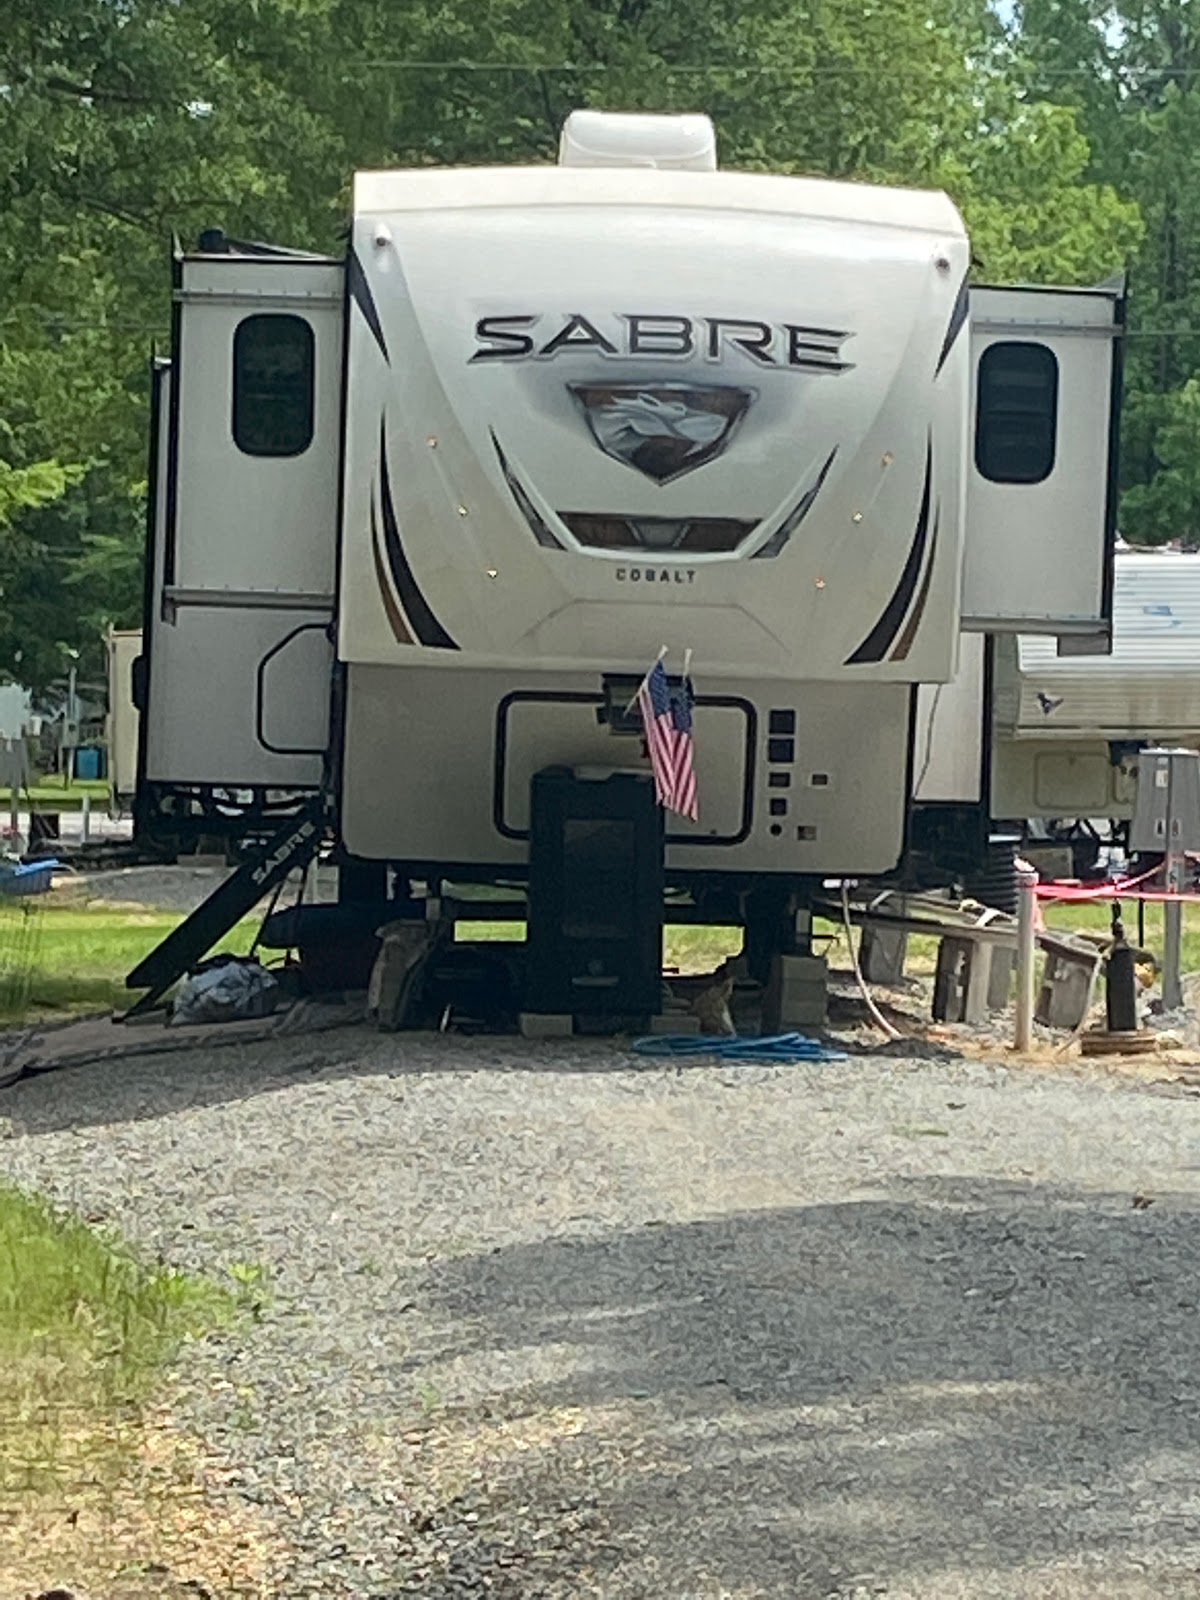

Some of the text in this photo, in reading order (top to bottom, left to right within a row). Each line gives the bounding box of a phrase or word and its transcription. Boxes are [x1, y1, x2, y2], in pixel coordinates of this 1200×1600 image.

[467, 313, 857, 375] SABRE
[615, 568, 696, 583] COBALT
[251, 821, 316, 885] SABRE
